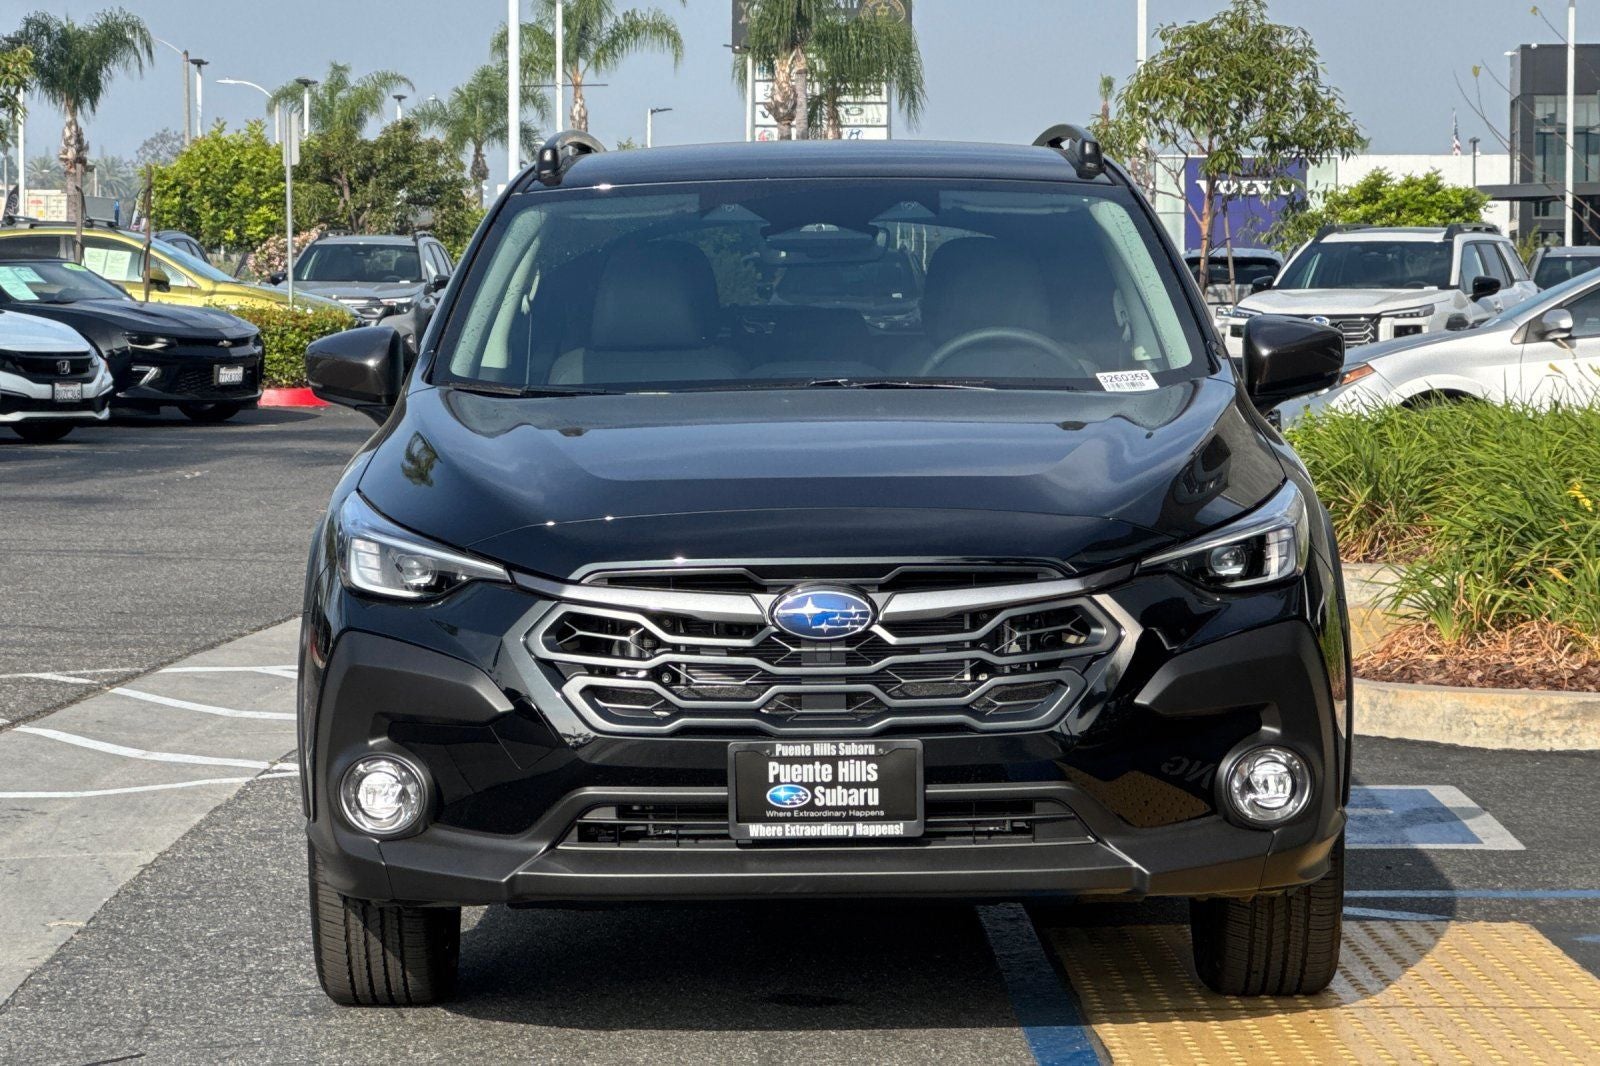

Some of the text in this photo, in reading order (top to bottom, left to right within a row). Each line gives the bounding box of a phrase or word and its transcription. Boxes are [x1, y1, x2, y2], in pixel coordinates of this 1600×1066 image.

[776, 743, 875, 756] Puente Hills Subaru
[768, 760, 878, 783] Puente Hills
[814, 786, 879, 806] Subaru
[794, 810, 846, 818] Extraordinary
[849, 809, 884, 817] Happens
[749, 823, 903, 837] Where Extraordinary Happens!
